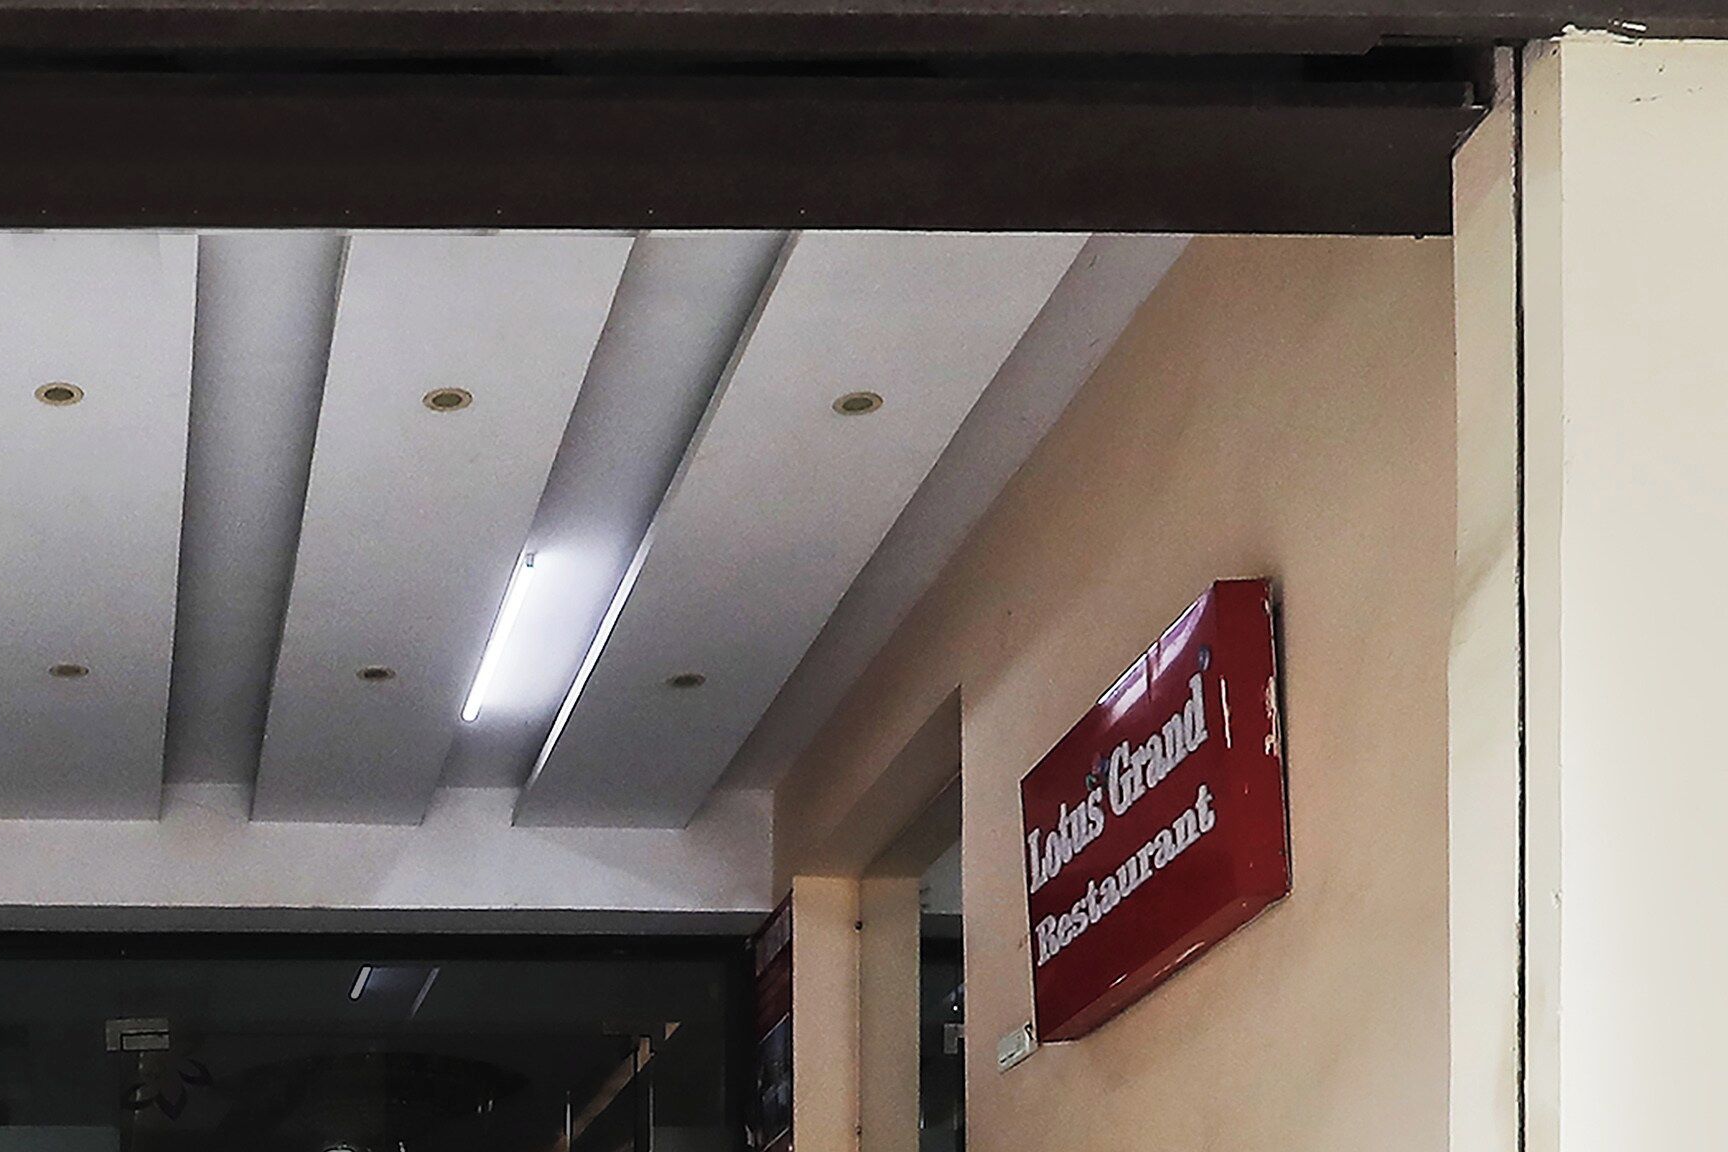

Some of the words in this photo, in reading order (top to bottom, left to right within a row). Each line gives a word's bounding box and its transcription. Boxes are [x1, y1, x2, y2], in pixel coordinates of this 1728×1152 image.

[1027, 785, 1105, 894] Lotus
[1107, 672, 1208, 815] Grand
[1036, 784, 1216, 966] Restaurant
